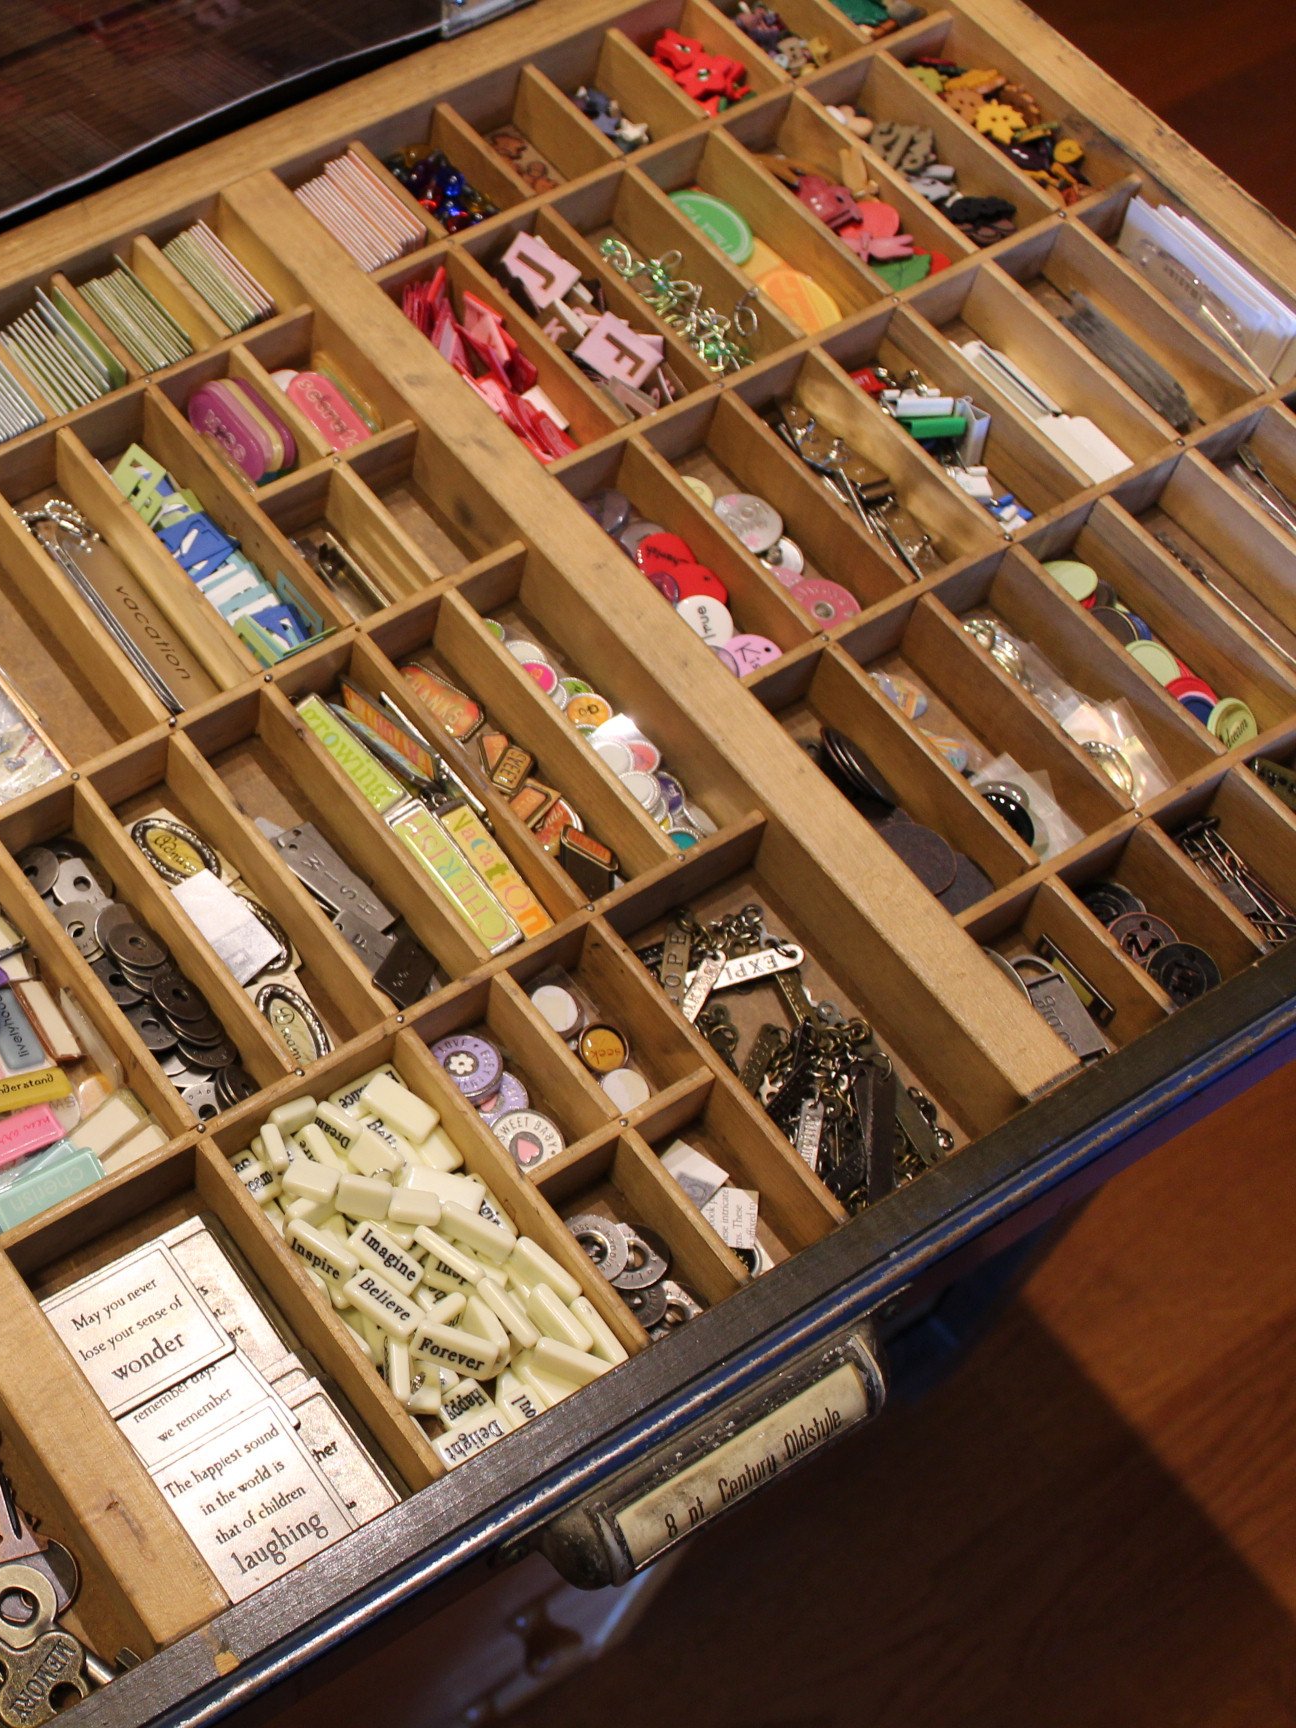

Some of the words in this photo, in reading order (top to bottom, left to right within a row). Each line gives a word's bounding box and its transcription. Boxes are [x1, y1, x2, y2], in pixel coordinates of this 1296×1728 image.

[115, 584, 191, 681] vacation
[299, 705, 397, 810] growing
[400, 811, 509, 942] CHERISH
[589, 1044, 623, 1064] seek
[23, 1114, 52, 1135] new
[314, 1116, 352, 1150] Dream
[497, 1114, 531, 1143] SWEET
[533, 1117, 559, 1149] BABY
[6, 1164, 85, 1217] cherish
[289, 1236, 341, 1281] Inspire
[360, 1228, 417, 1282] Imagine
[70, 1308, 102, 1333] May
[102, 1296, 128, 1321] you
[128, 1277, 158, 1303] never
[358, 1275, 412, 1322] Believe
[78, 1337, 107, 1363] lose
[107, 1324, 136, 1350] your
[136, 1306, 169, 1332] sense
[168, 1294, 185, 1313] of
[110, 1329, 186, 1383] wonder
[418, 1337, 485, 1371] Forever
[157, 1425, 176, 1445] we
[174, 1386, 234, 1432] remember
[443, 1387, 488, 1421] Happy
[163, 1472, 194, 1501] The
[191, 1444, 244, 1487] happiest
[245, 1422, 281, 1455] sound
[444, 1419, 505, 1462] Delight
[200, 1498, 217, 1517] in
[216, 1485, 238, 1510] the
[237, 1464, 272, 1494] world
[271, 1458, 286, 1477] is
[664, 1513, 679, 1538] 8
[717, 1455, 779, 1505] Century
[783, 1406, 843, 1461] Oldstyle
[215, 1520, 242, 1546] that
[241, 1507, 260, 1529] of
[258, 1484, 307, 1521] children
[230, 1511, 330, 1577] laughing
[8, 1638, 77, 1724] MEMORY
